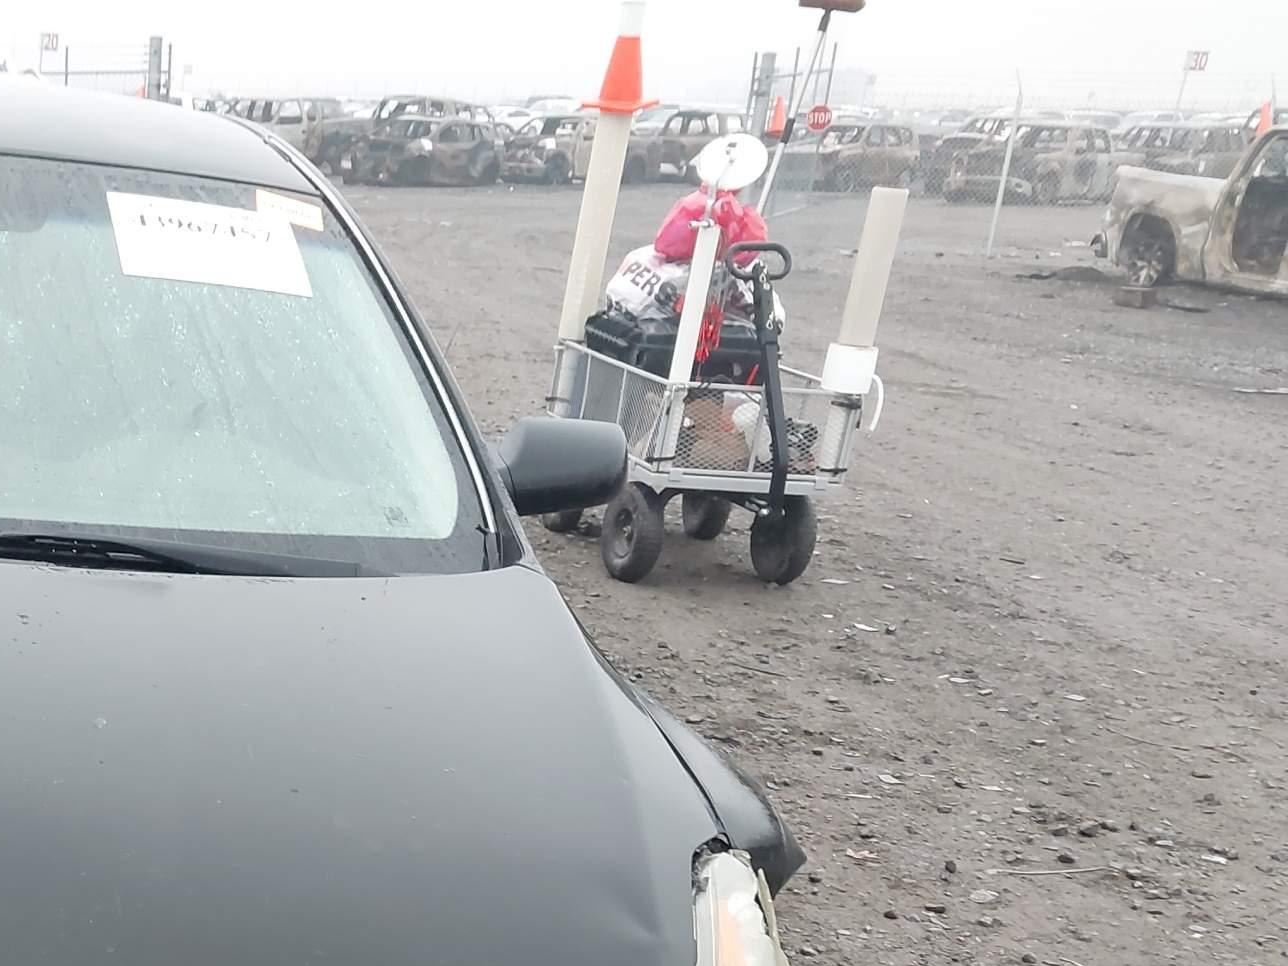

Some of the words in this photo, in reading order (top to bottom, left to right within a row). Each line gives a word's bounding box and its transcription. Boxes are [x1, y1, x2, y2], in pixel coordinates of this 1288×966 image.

[44, 33, 59, 50] 20
[1189, 51, 1209, 71] 30
[809, 112, 832, 124] STOP
